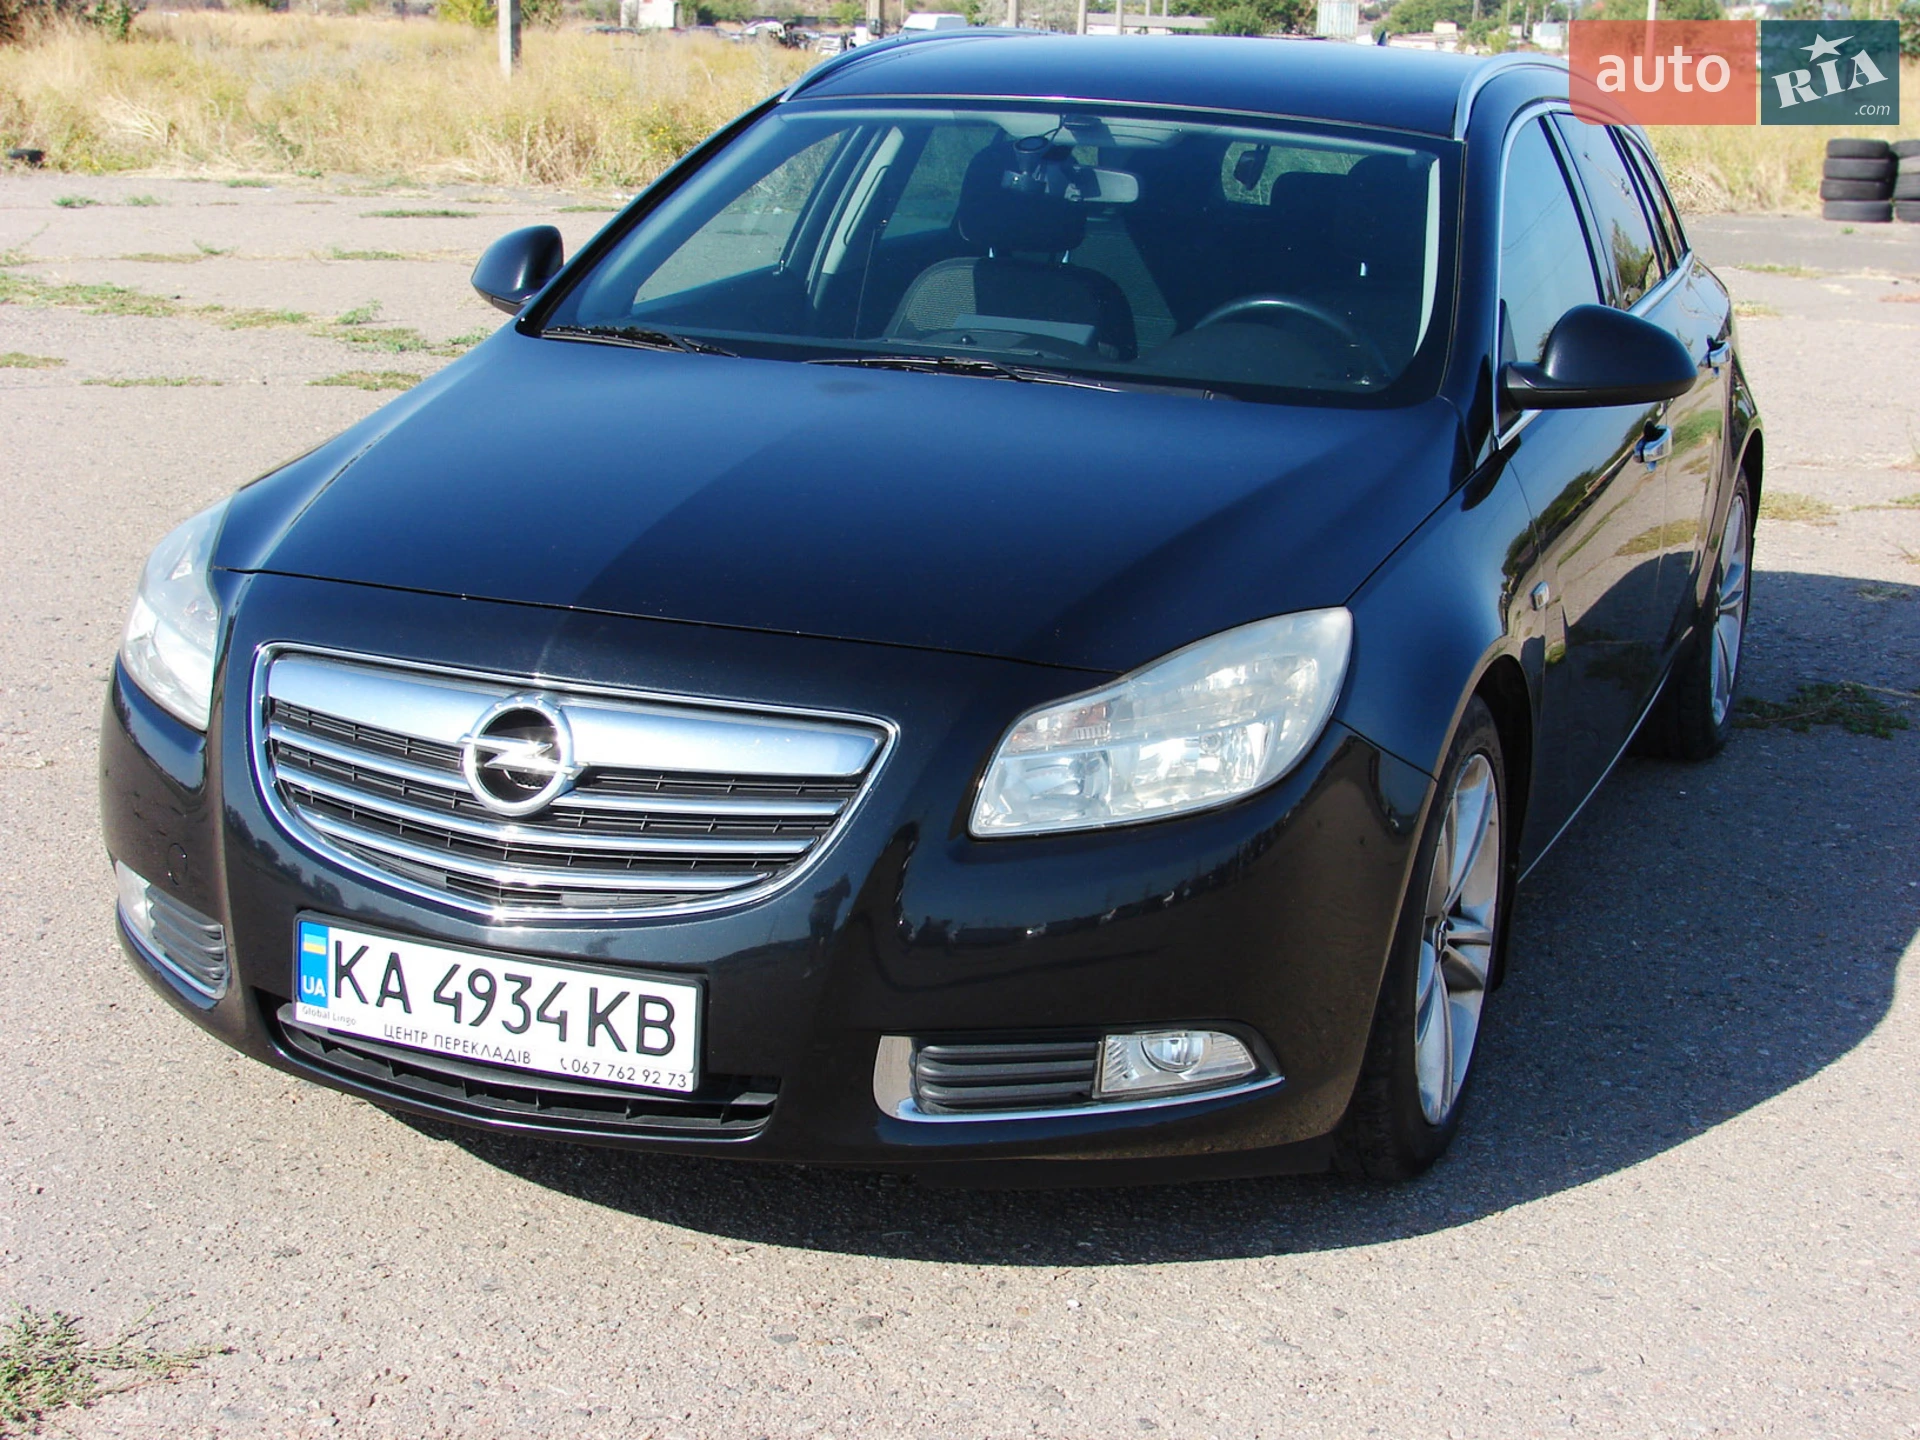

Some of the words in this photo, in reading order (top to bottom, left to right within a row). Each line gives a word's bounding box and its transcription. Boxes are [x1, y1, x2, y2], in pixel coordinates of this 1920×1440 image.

[302, 975, 327, 998] UA
[334, 940, 413, 1014] KA
[433, 964, 568, 1043] 4934
[587, 987, 676, 1057] KB
[301, 1005, 331, 1022] Global
[332, 1012, 357, 1026] Lingo
[383, 1023, 429, 1044] ЦЕНТР
[433, 1033, 532, 1065] ПЕРЕКЛАДІВ
[571, 1058, 601, 1075] 067
[605, 1063, 636, 1081] 762
[641, 1069, 662, 1084] 92
[667, 1073, 688, 1088] 73
